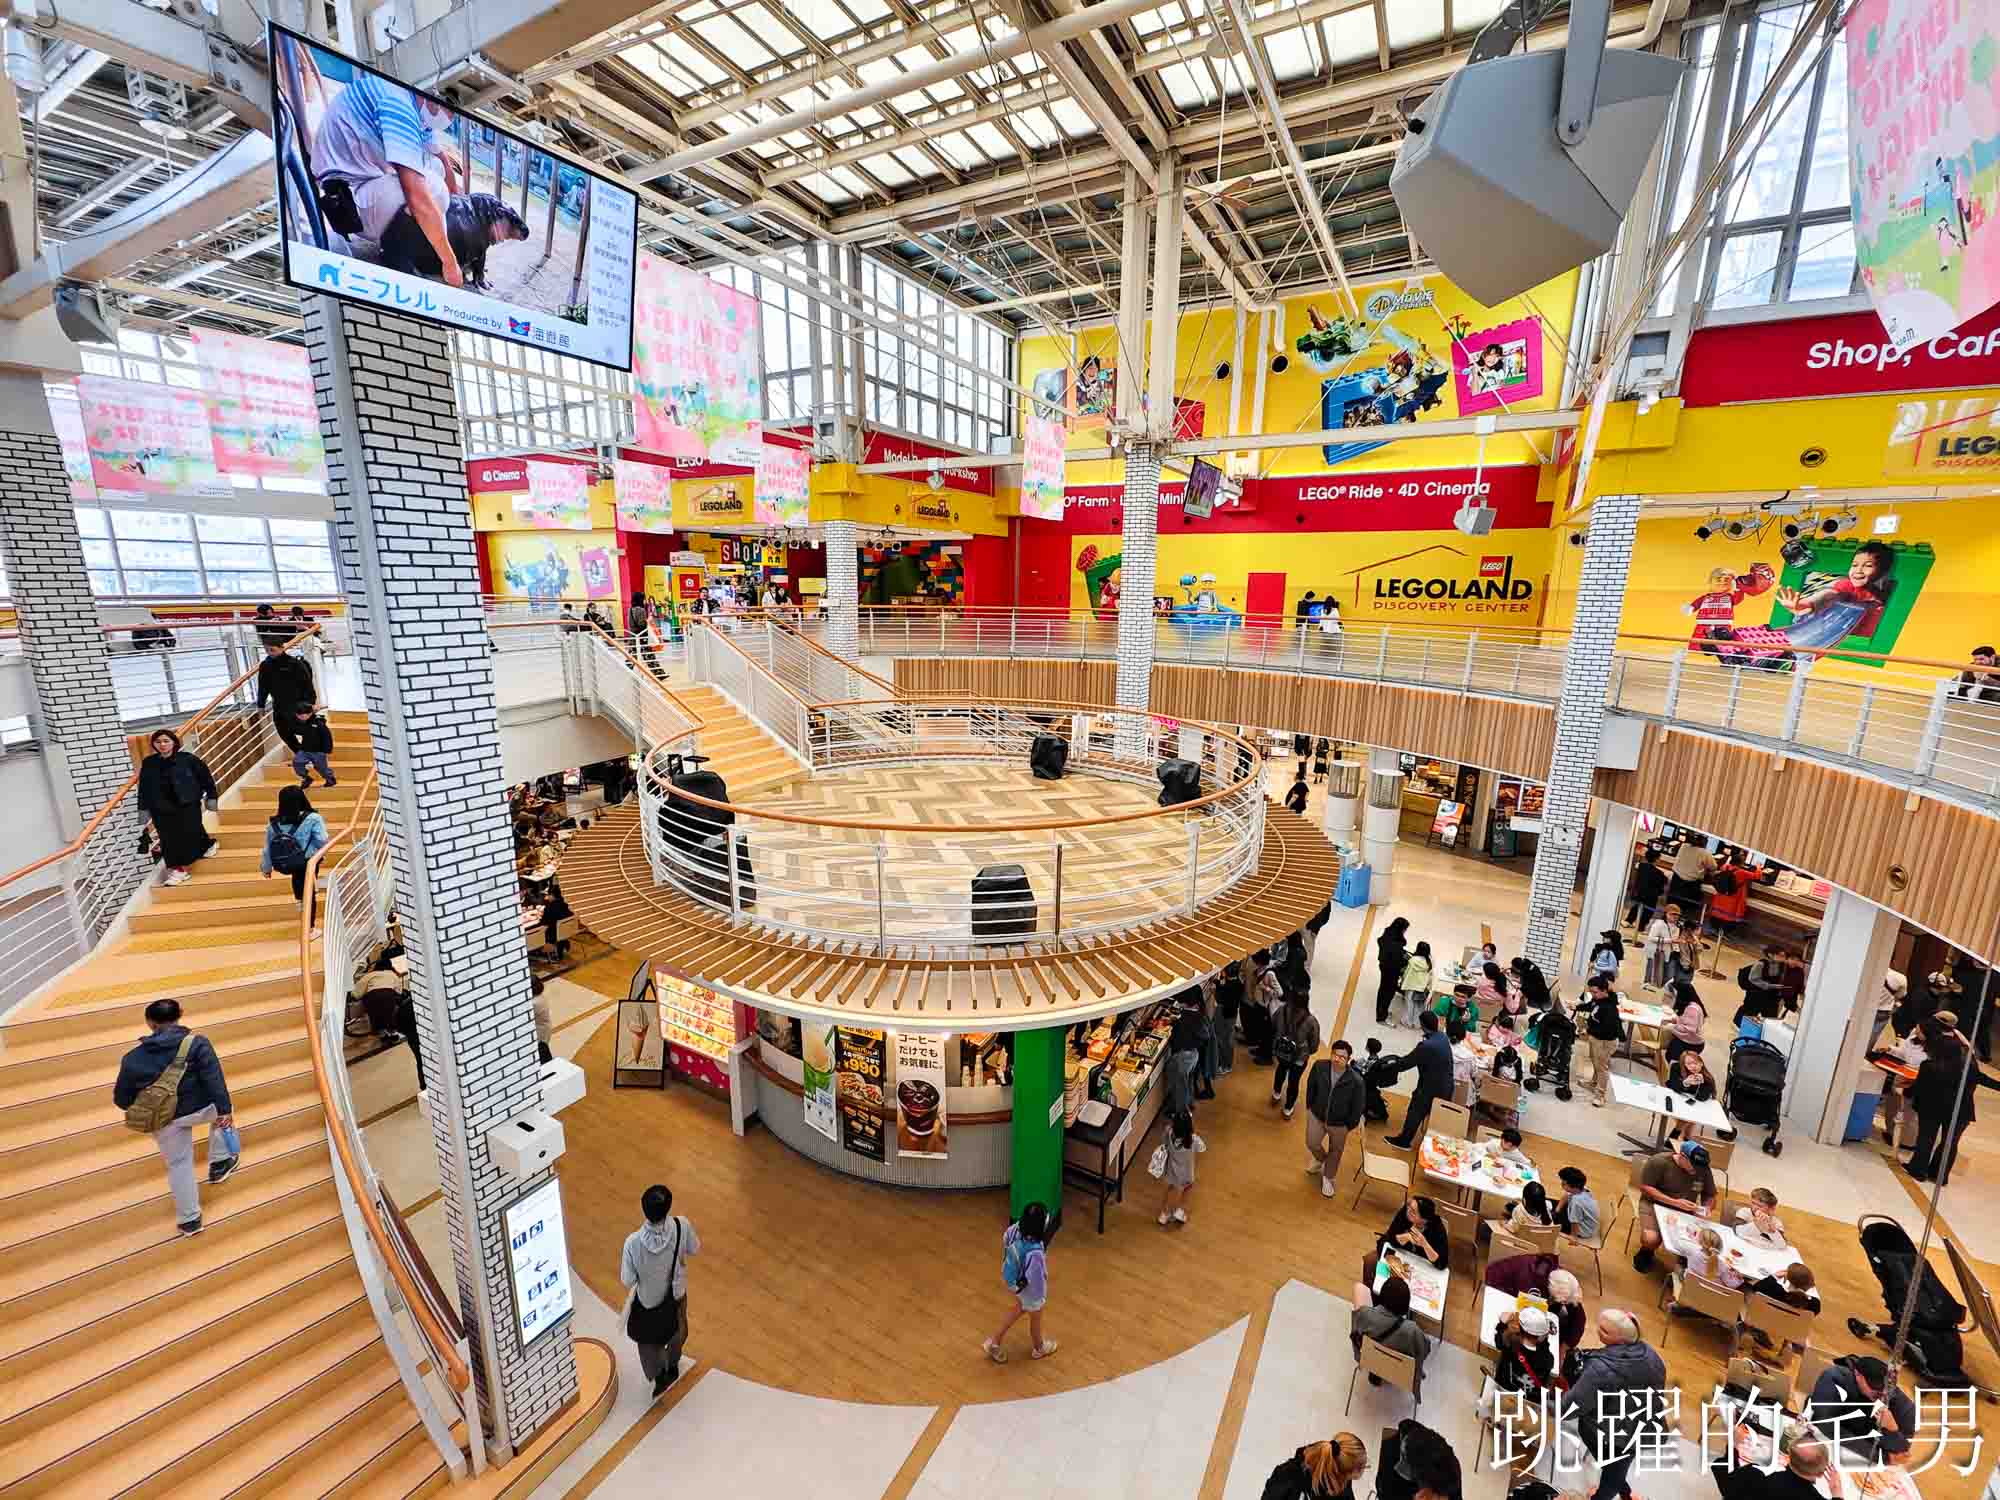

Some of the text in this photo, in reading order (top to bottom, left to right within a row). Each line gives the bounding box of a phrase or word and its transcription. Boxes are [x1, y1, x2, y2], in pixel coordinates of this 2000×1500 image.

[349, 272, 437, 312] ニフレル
[491, 318, 503, 330] by
[1806, 339, 1913, 372] Shop,
[482, 471, 493, 482] 4D
[1348, 484, 1384, 499] Ride
[1397, 482, 1420, 497] 4D
[1423, 480, 1491, 496] Cinema
[1078, 495, 1109, 508] Farm
[722, 541, 761, 562] SHOP
[1482, 561, 1503, 571] LEGO
[1375, 556, 1532, 600] LEGOLAND
[1374, 601, 1529, 613] DISCOVERY CENTER
[899, 1033, 937, 1045] コーヒー
[899, 1045, 938, 1058] だけでも
